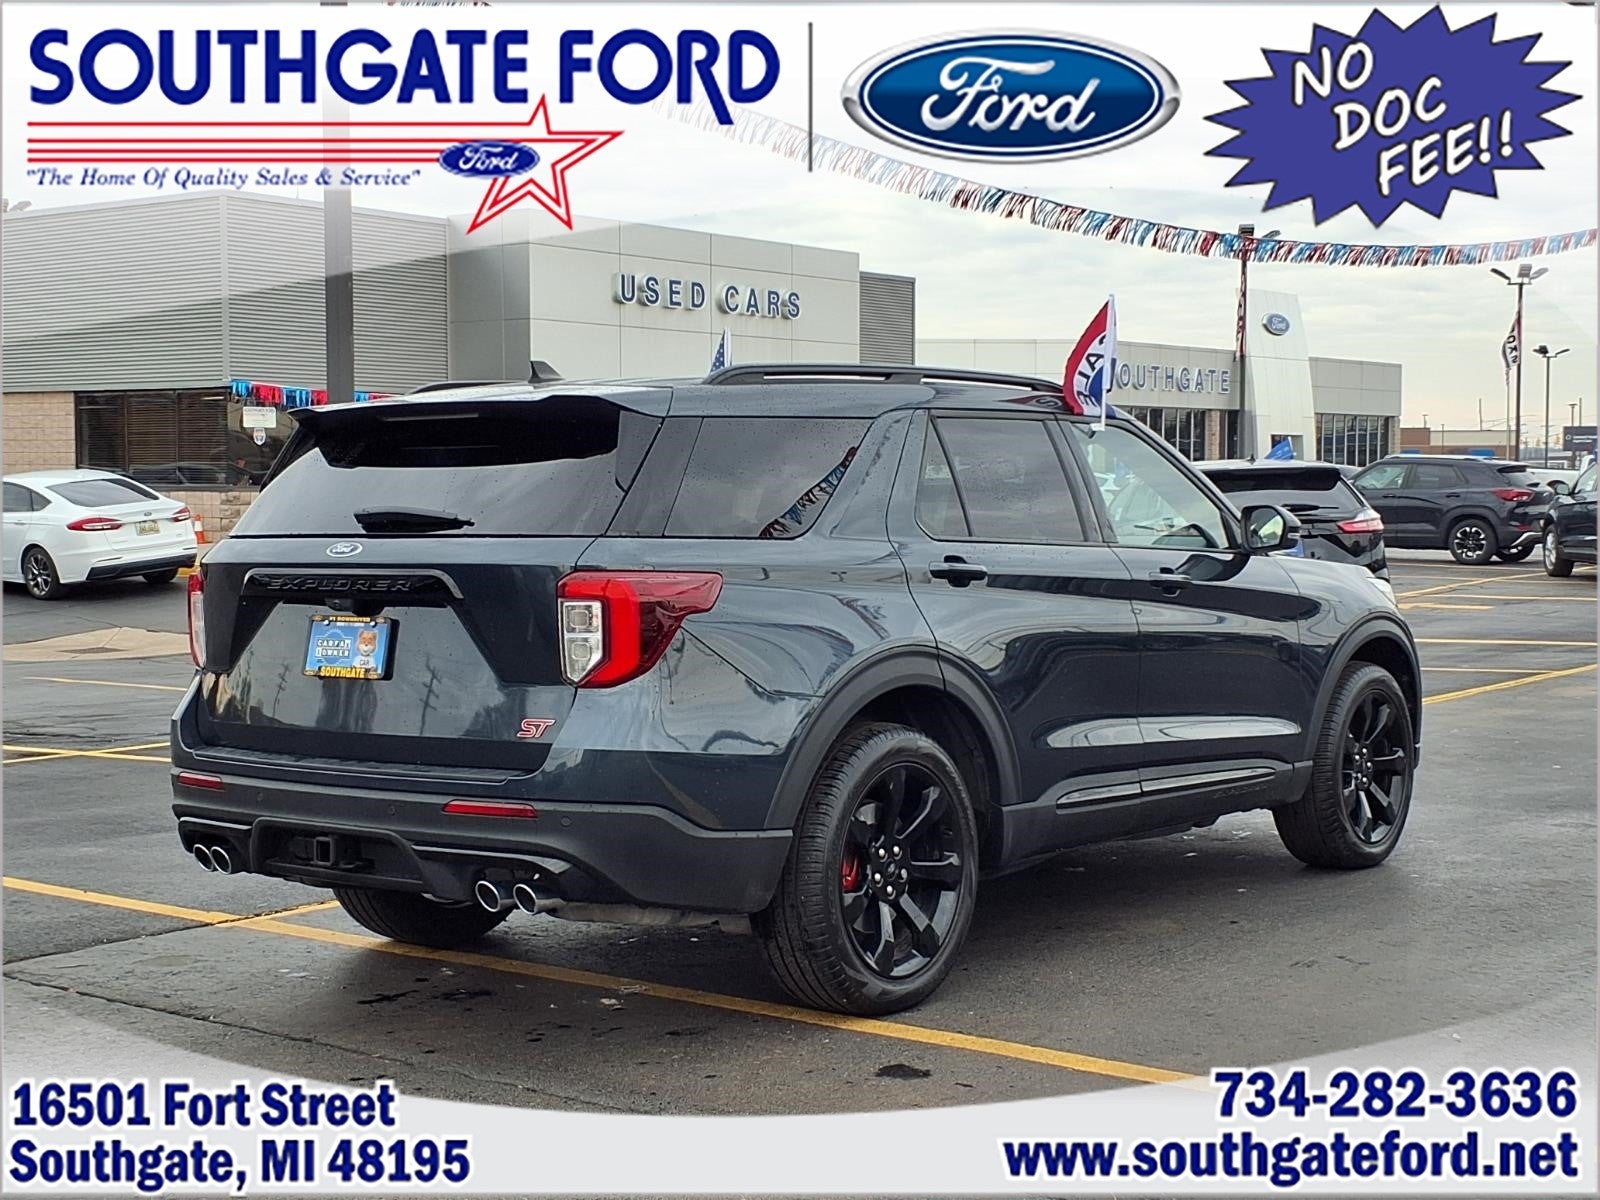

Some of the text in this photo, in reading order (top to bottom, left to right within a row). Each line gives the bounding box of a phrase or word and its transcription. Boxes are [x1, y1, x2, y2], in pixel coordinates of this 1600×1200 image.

[618, 273, 801, 319] USED CARS
[1115, 361, 1232, 395] OUTHGATE
[266, 578, 412, 592] EXPLORER
[320, 666, 366, 678] SOUTHGATE
[516, 718, 556, 738] ST
